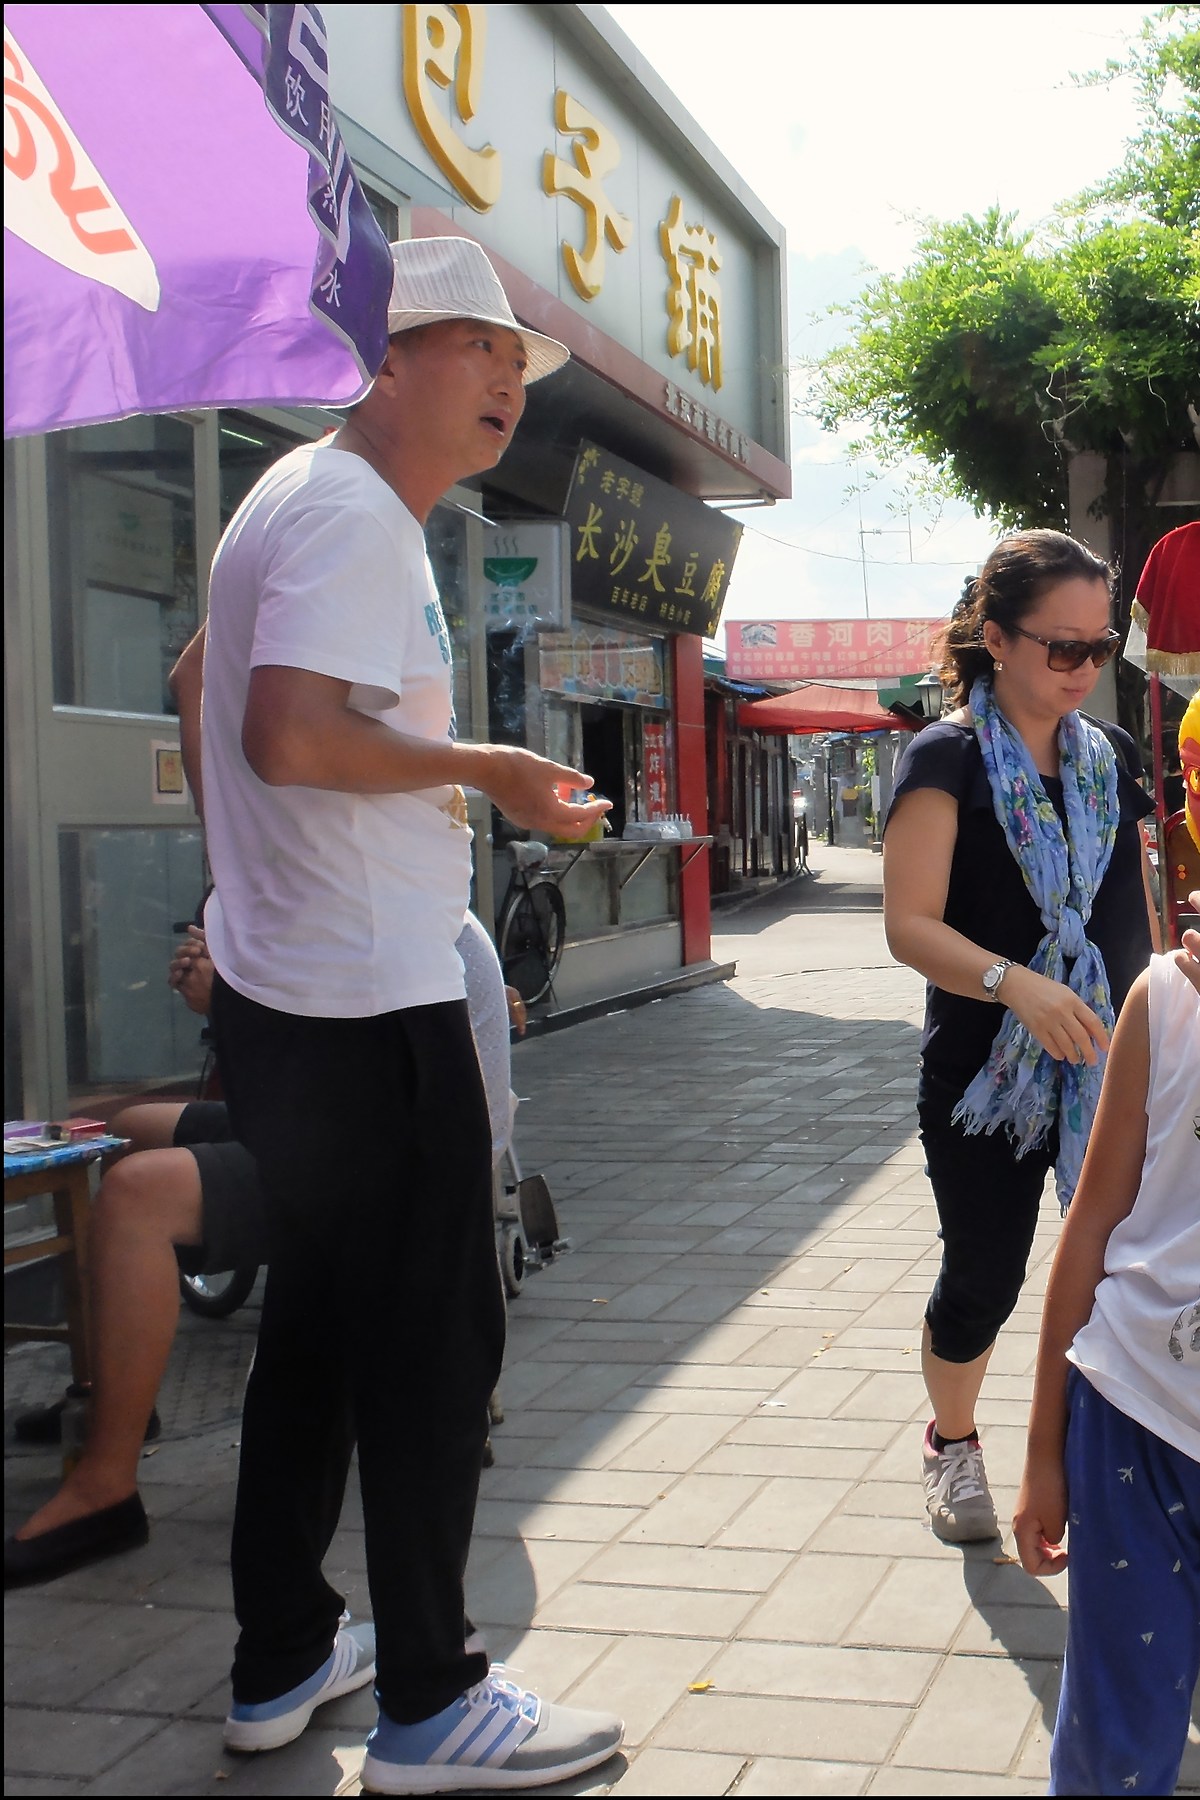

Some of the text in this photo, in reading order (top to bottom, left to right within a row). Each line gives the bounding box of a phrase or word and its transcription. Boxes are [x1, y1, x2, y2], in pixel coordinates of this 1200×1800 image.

[402, 4, 737, 394] 包子铺
[576, 502, 725, 609] 长沙臭豆腐
[789, 622, 931, 648] 香河肉饼
